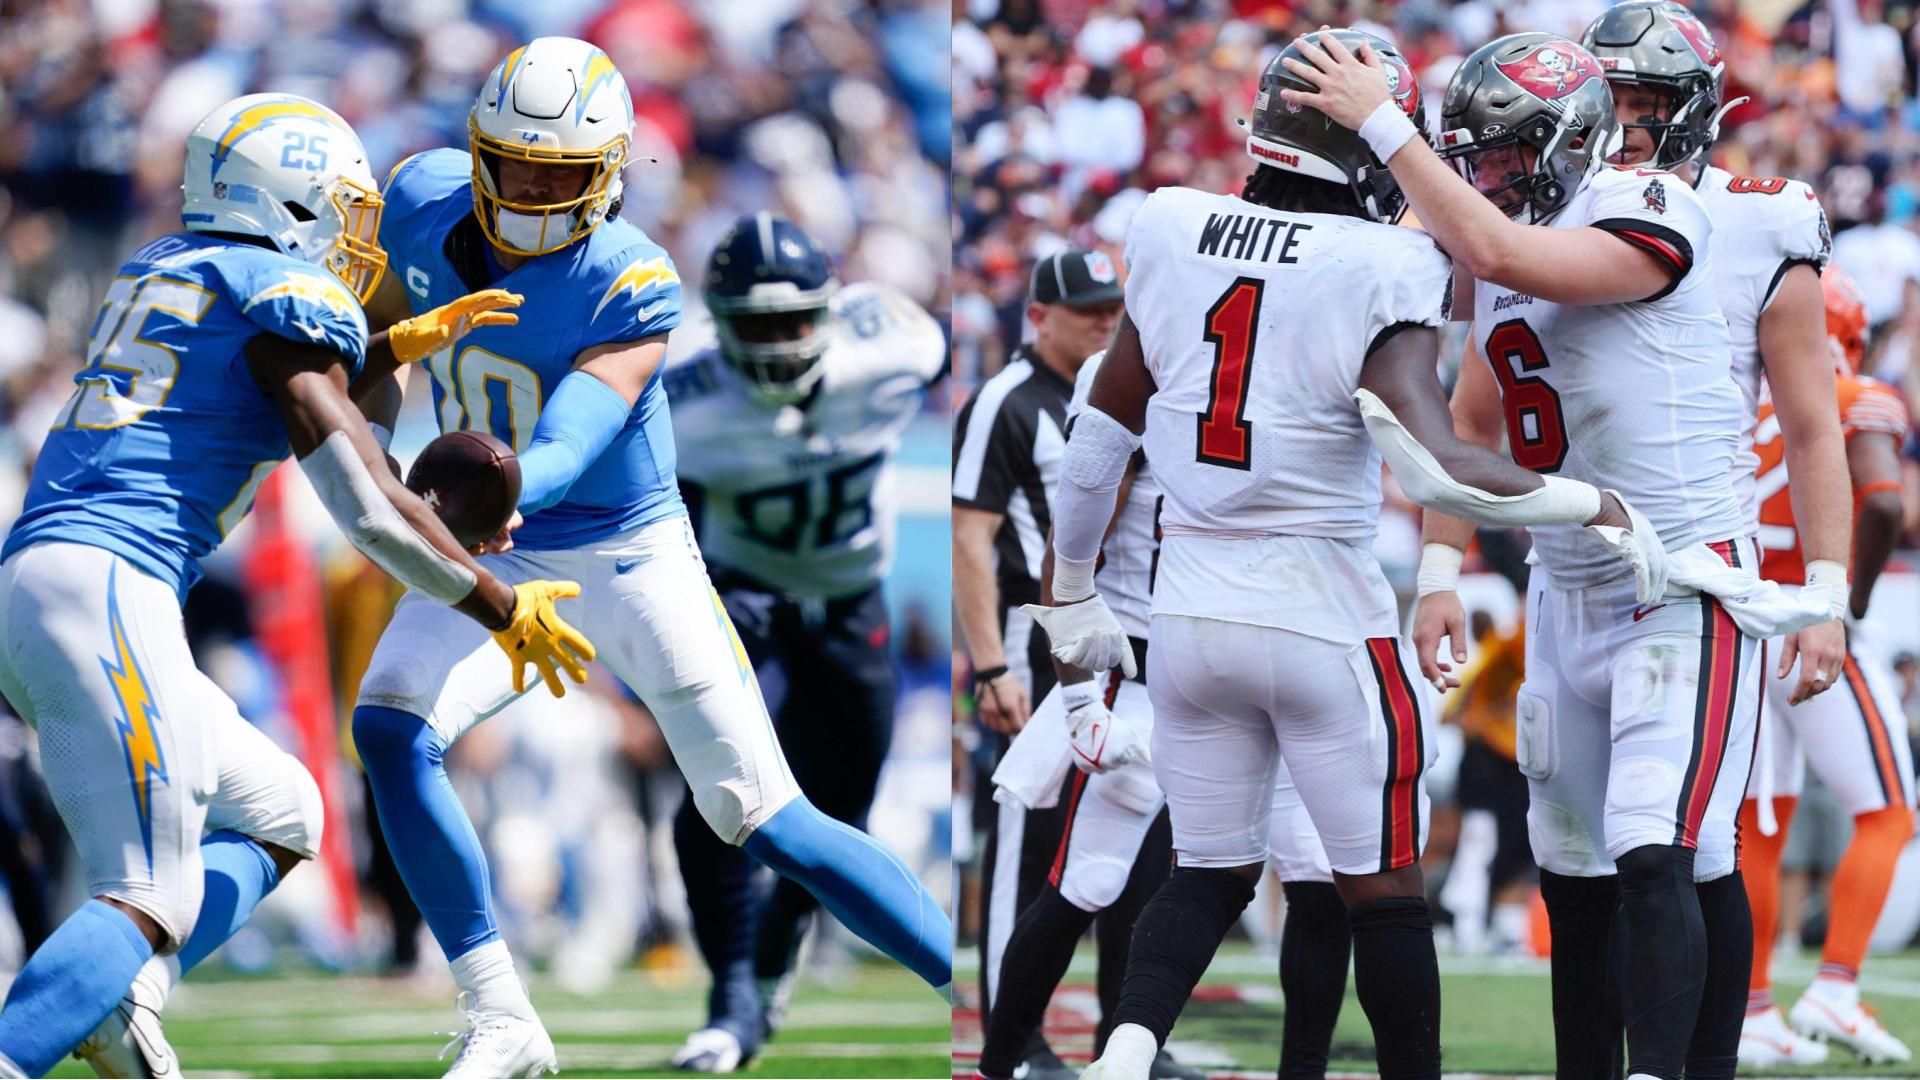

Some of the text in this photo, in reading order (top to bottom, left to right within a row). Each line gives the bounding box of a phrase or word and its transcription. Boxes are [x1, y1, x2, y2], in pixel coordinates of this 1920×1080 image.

[280, 131, 328, 171] 25
[522, 132, 540, 144] LA
[1197, 213, 1313, 264] WHITE
[406, 266, 430, 298] C
[1196, 276, 1265, 471] 1
[1485, 318, 1570, 474] 6
[429, 345, 543, 456] 10
